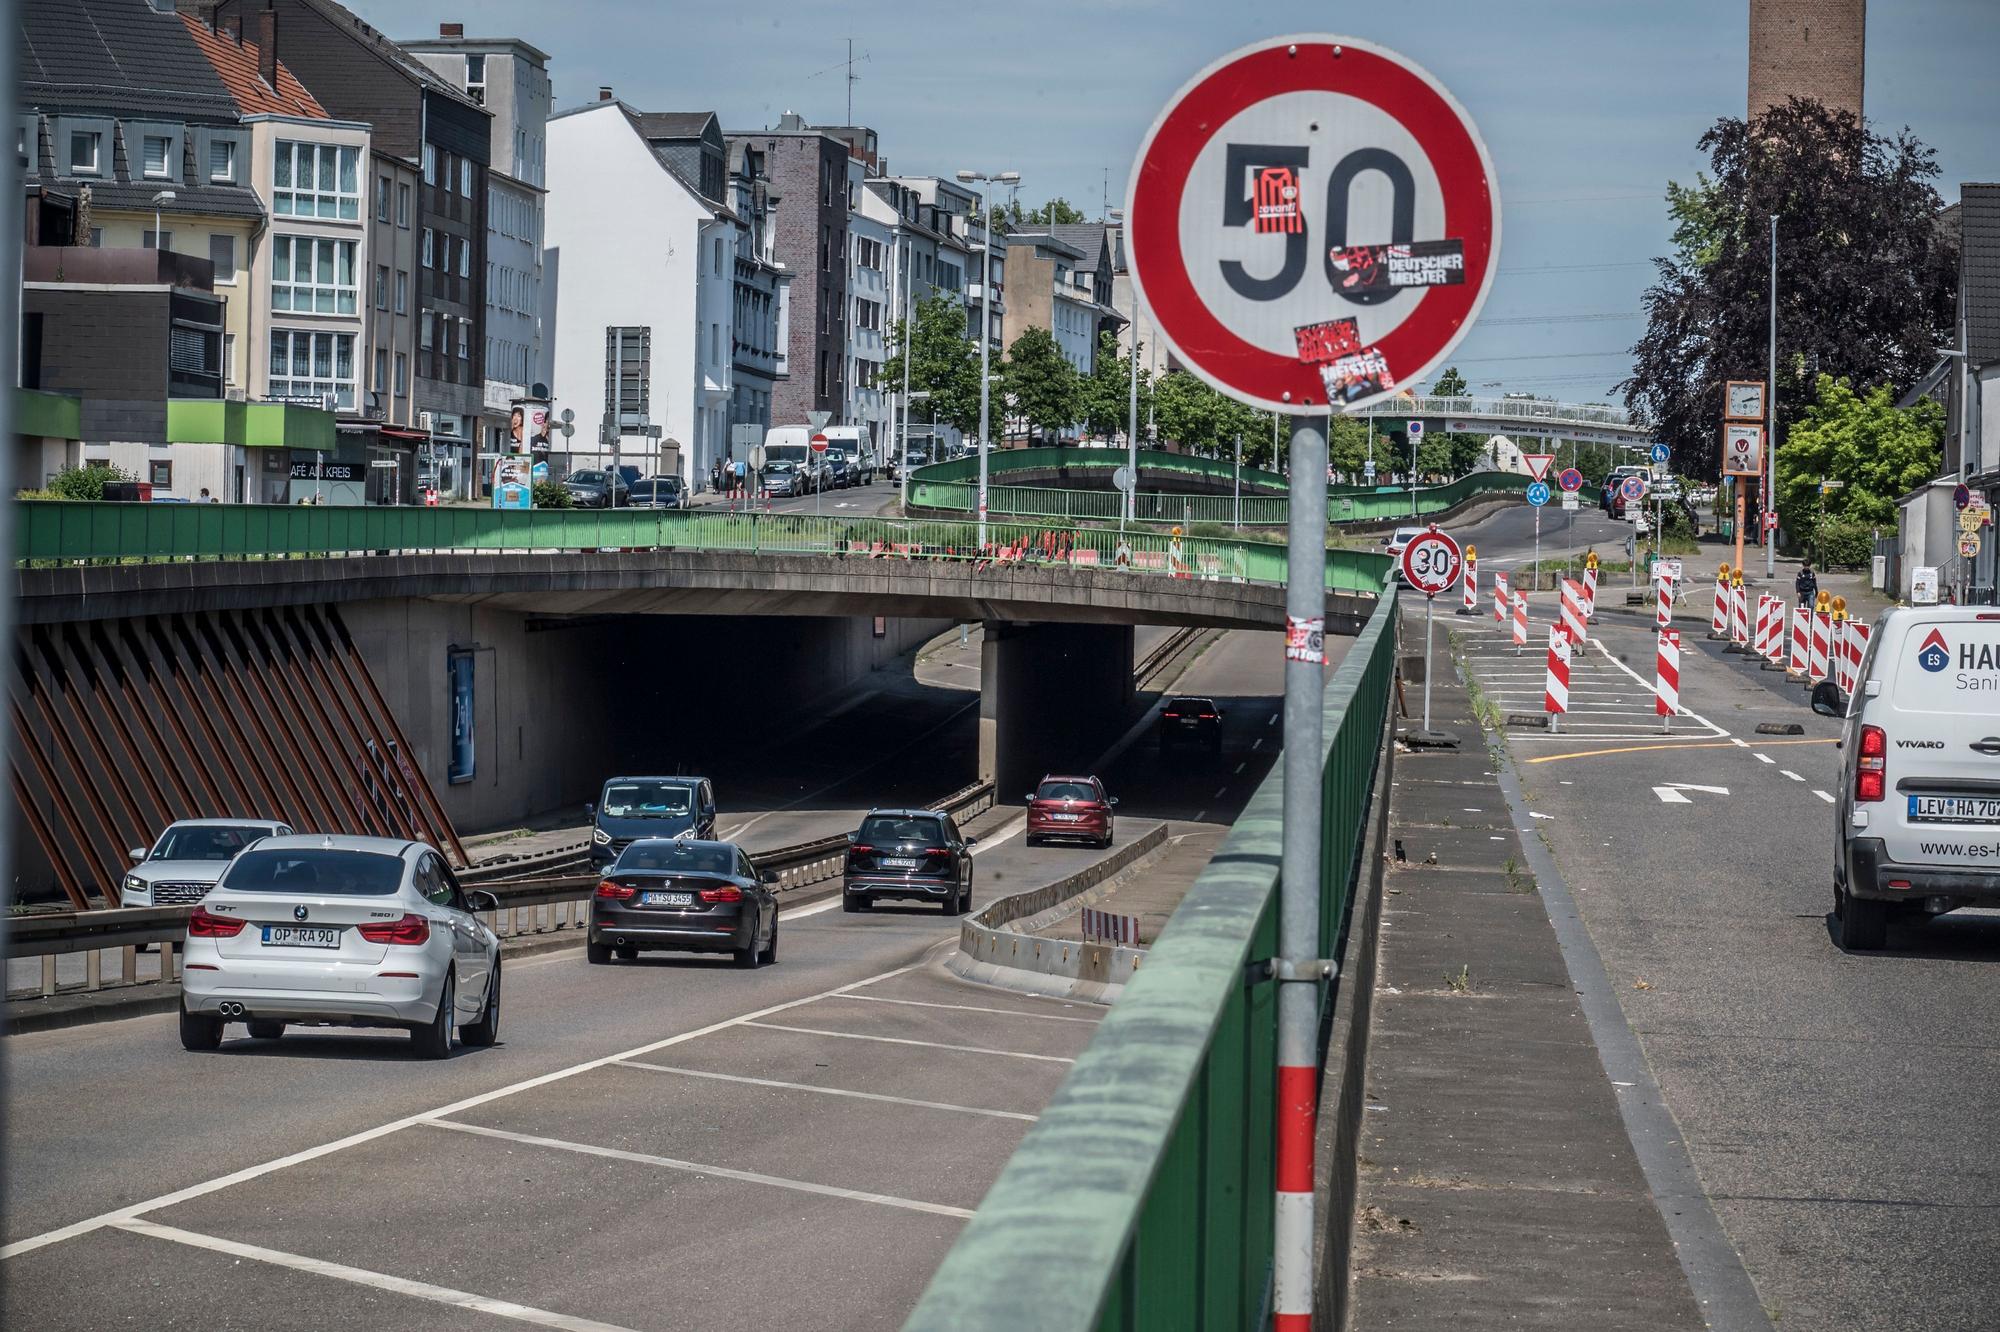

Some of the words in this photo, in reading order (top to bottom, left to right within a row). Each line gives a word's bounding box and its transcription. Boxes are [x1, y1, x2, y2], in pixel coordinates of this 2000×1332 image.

[1219, 143, 1415, 305] 50
[1389, 254, 1463, 271] DEUTSCHER
[1389, 269, 1447, 285] MEISTER
[326, 466, 351, 479] KREIS
[1416, 548, 1449, 575] 30
[1927, 653, 1941, 666] ES
[1956, 673, 1998, 691] Sani
[1895, 740, 1945, 749] VIVARO
[1918, 799, 1946, 815] LEV
[1956, 800, 1975, 816] HA
[215, 904, 236, 912] GT
[274, 929, 291, 941] OP
[299, 930, 315, 942] RA
[318, 930, 334, 943] 90
